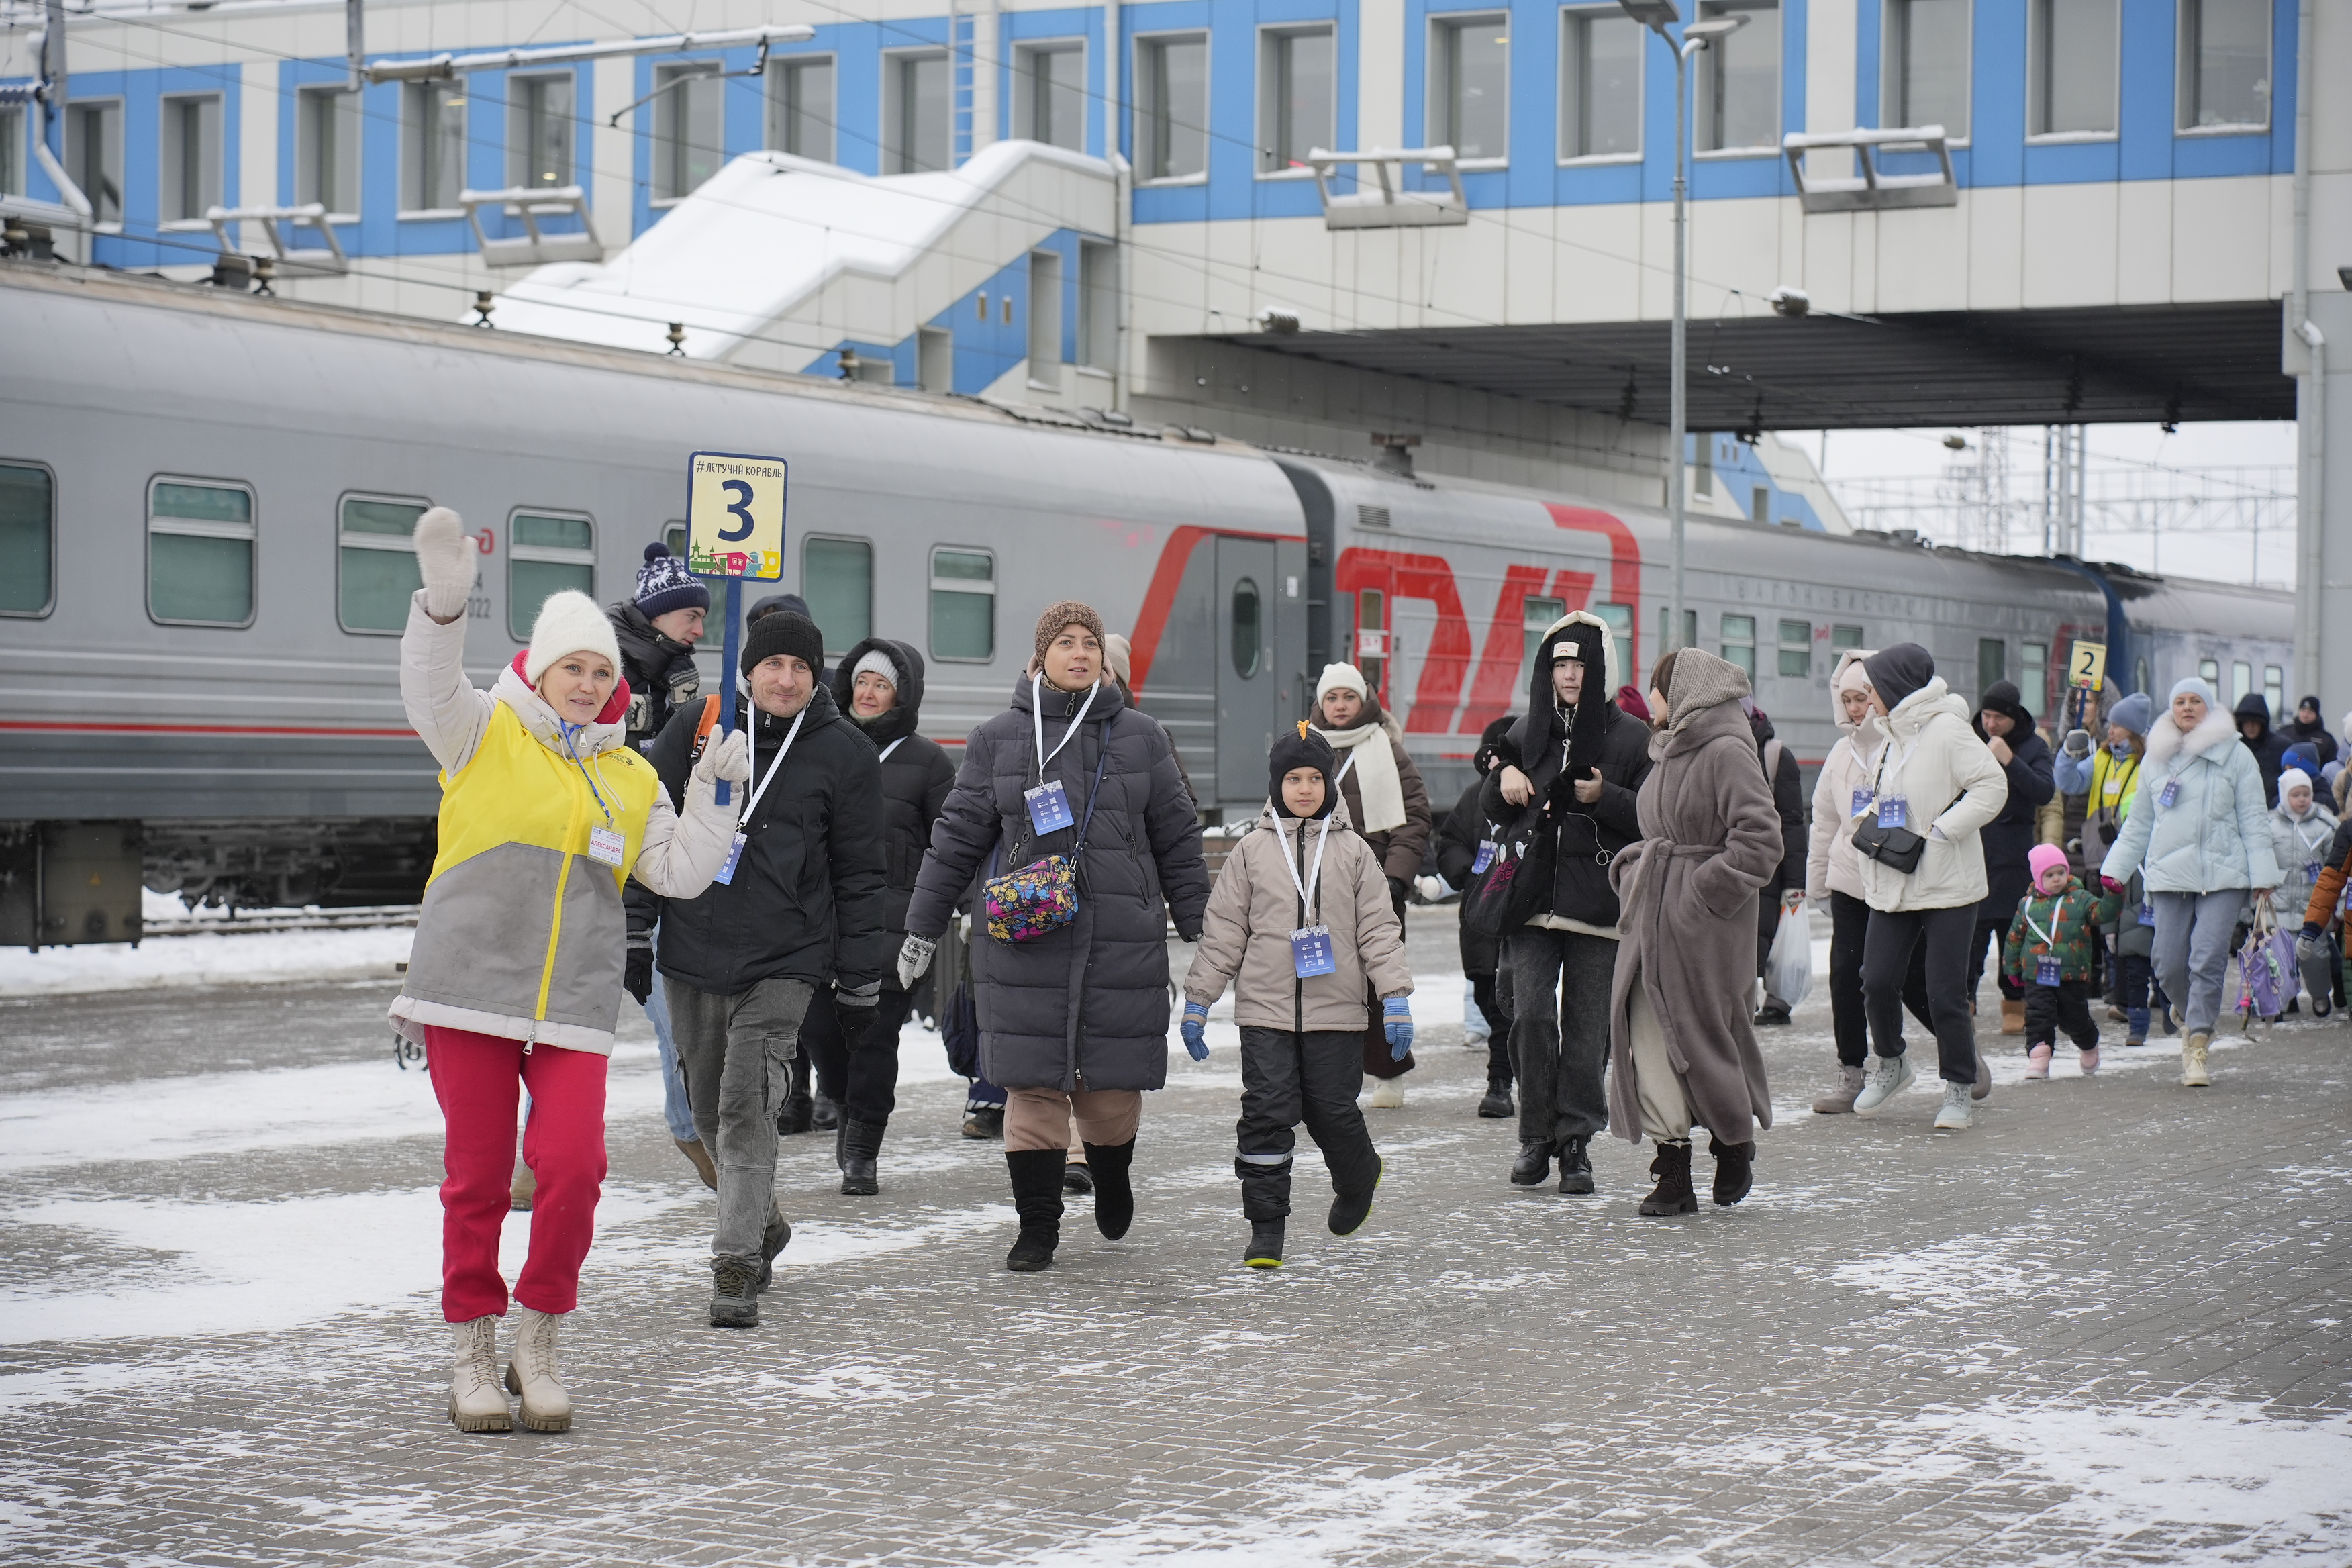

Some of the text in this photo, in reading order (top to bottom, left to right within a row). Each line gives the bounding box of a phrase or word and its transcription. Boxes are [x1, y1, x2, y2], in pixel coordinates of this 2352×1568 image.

[696, 460, 783, 478] #ЛЕТУЧИЙ КОРАБЛЬ
[717, 479, 754, 542] 3
[2079, 652, 2094, 675] 2
[591, 840, 621, 854] АЛЕКСАНДРА
